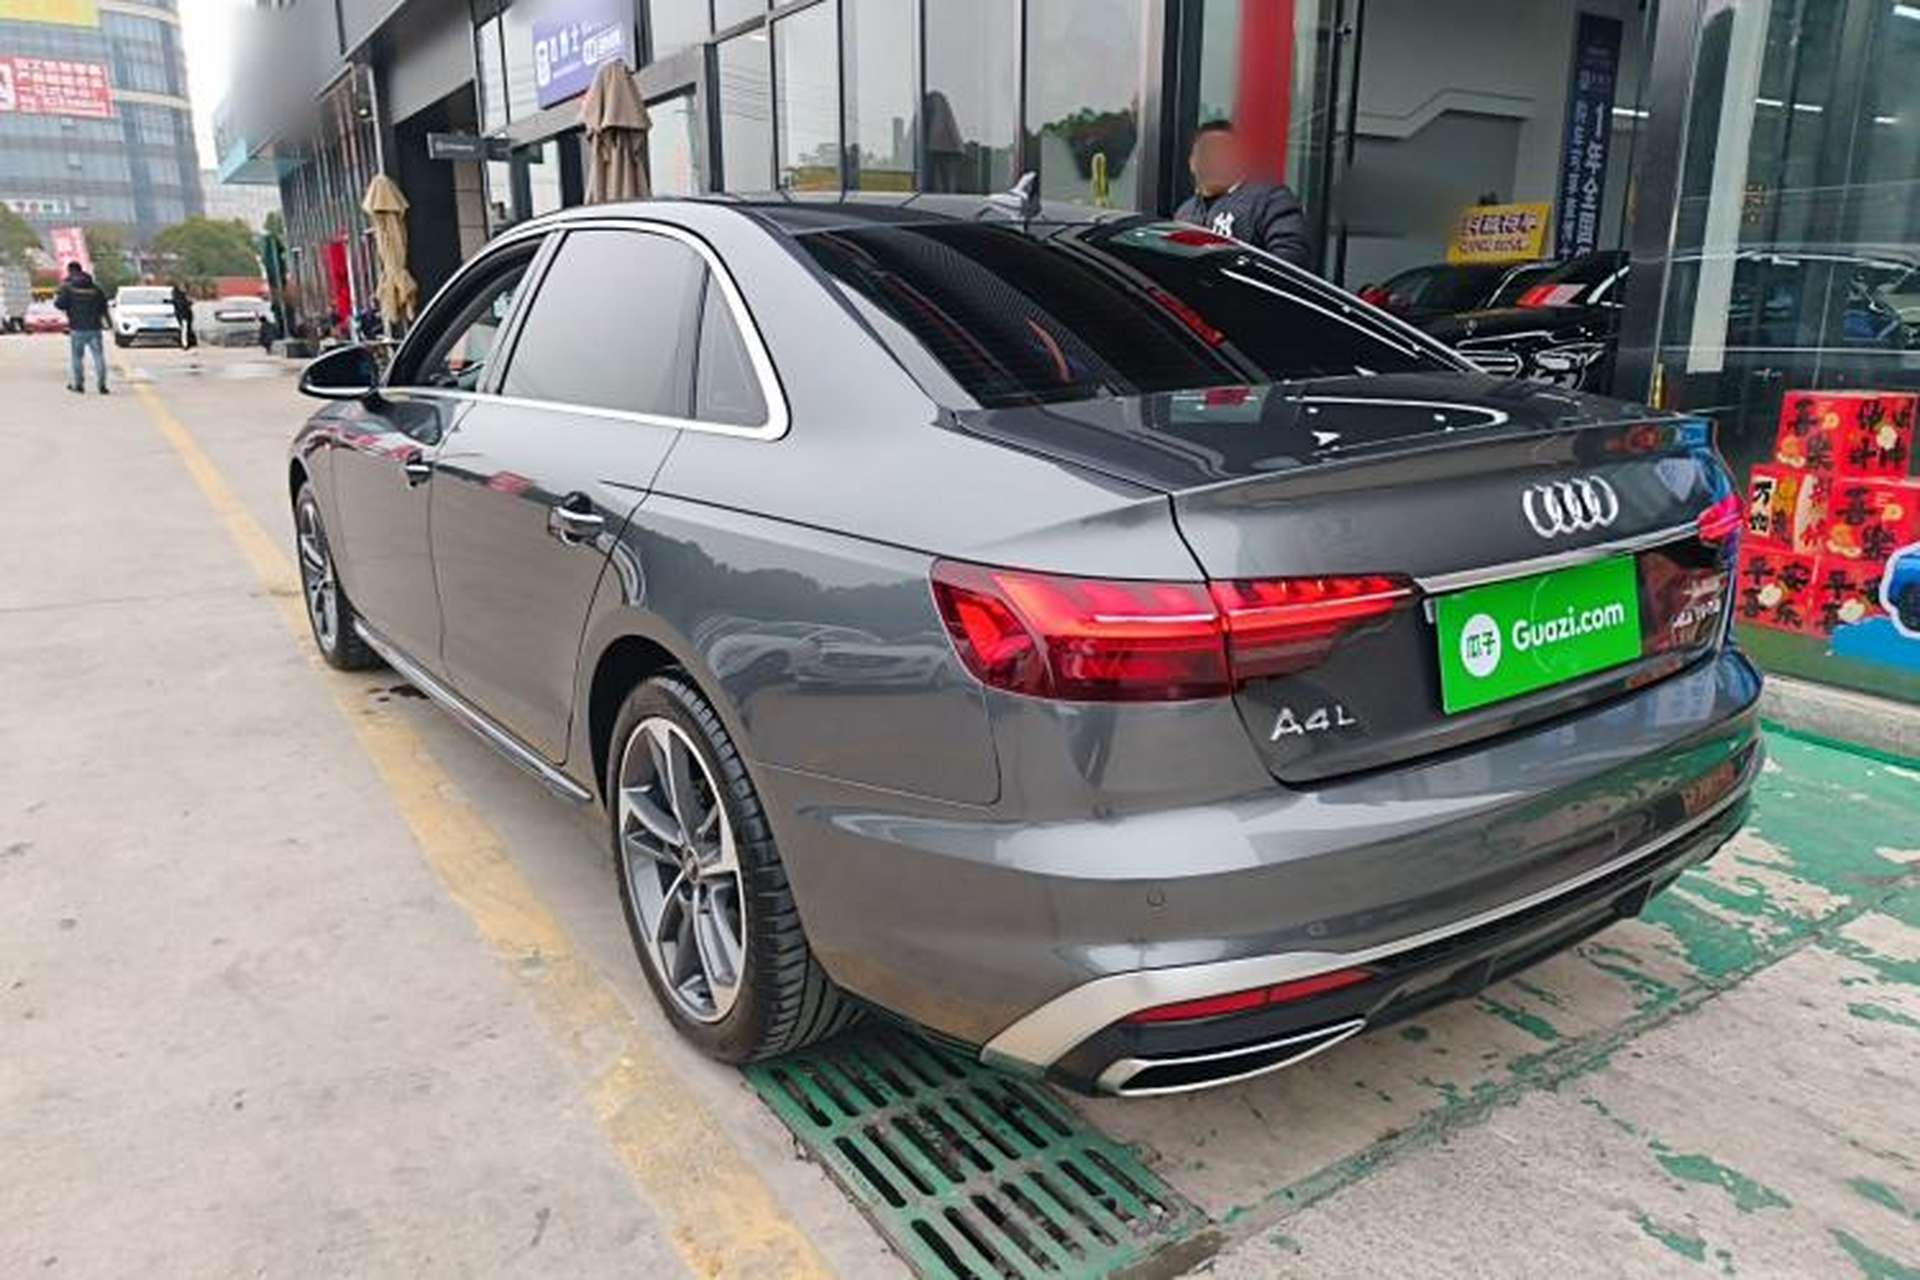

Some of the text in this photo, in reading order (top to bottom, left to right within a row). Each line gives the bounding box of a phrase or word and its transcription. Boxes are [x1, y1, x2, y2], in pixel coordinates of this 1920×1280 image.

[1512, 601, 1625, 651] Guazi.com
[1466, 630, 1496, 660] 瓜子
[1270, 705, 1356, 741] A4L
